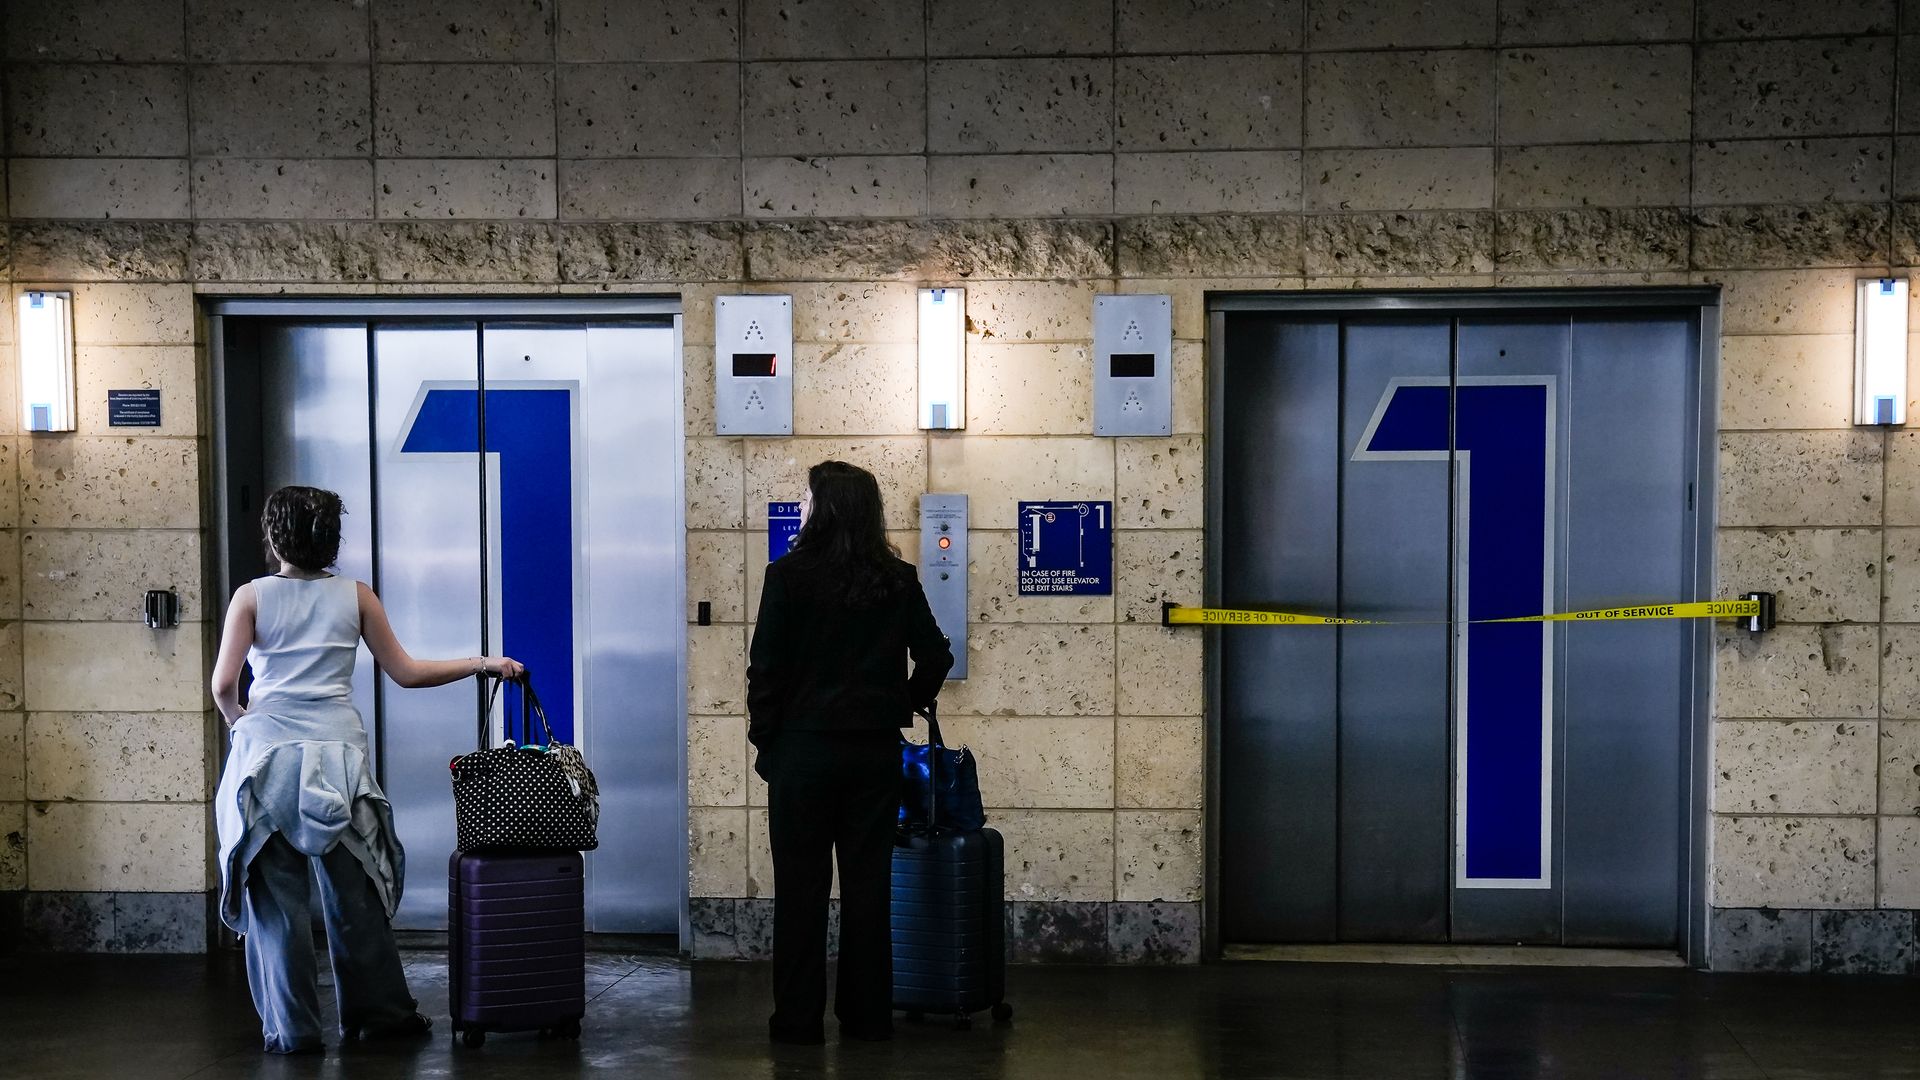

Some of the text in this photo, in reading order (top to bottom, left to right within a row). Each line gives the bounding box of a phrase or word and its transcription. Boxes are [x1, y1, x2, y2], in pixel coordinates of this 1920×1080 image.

[770, 356, 776, 374] 1
[778, 505, 799, 513] DIR
[1095, 505, 1104, 529] 1
[392, 380, 582, 749] 1
[1021, 577, 1034, 585] DO
[1035, 577, 1050, 585] NOT
[1051, 577, 1065, 585] USE
[1576, 606, 1675, 619] OUT OF SERVICE
[1351, 374, 1557, 888] 1
